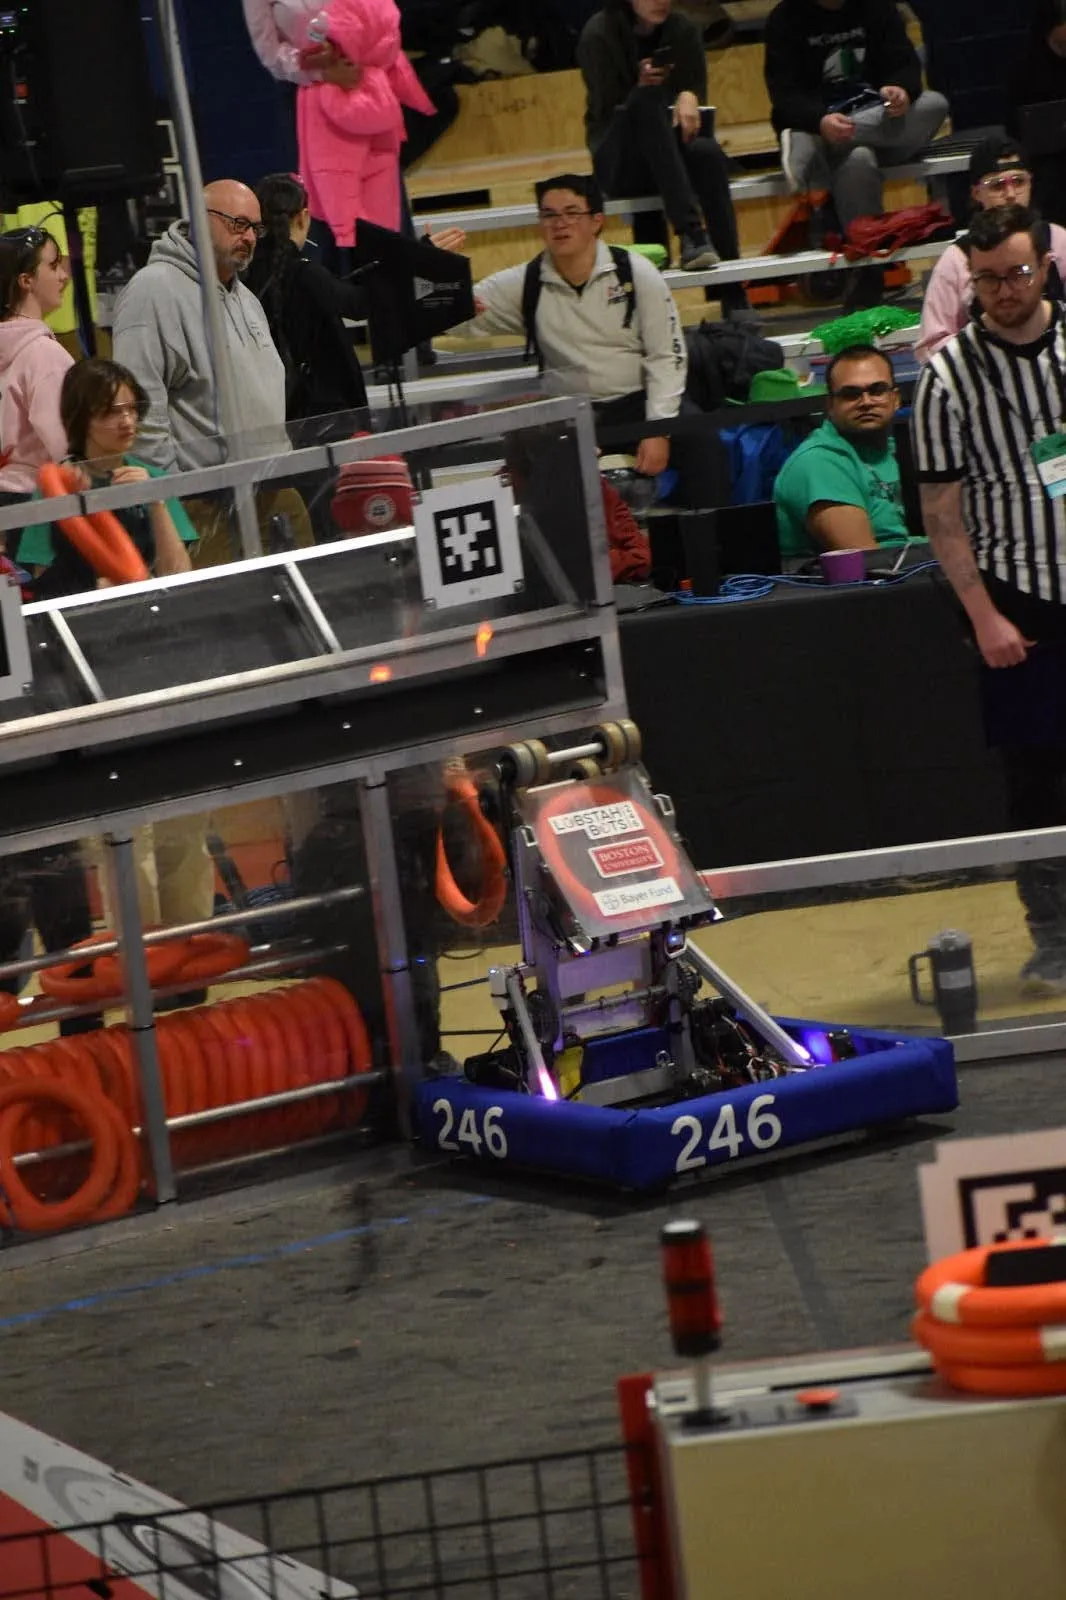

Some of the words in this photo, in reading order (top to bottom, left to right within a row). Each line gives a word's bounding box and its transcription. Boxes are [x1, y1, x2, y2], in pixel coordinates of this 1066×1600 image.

[552, 808, 622, 831] LOBSTAH
[590, 819, 628, 836] BOTS
[598, 845, 650, 862] BOSTON
[620, 891, 649, 905] Bayer
[649, 884, 674, 899] Fund
[432, 1098, 508, 1158] 246
[670, 1094, 782, 1172] 246
